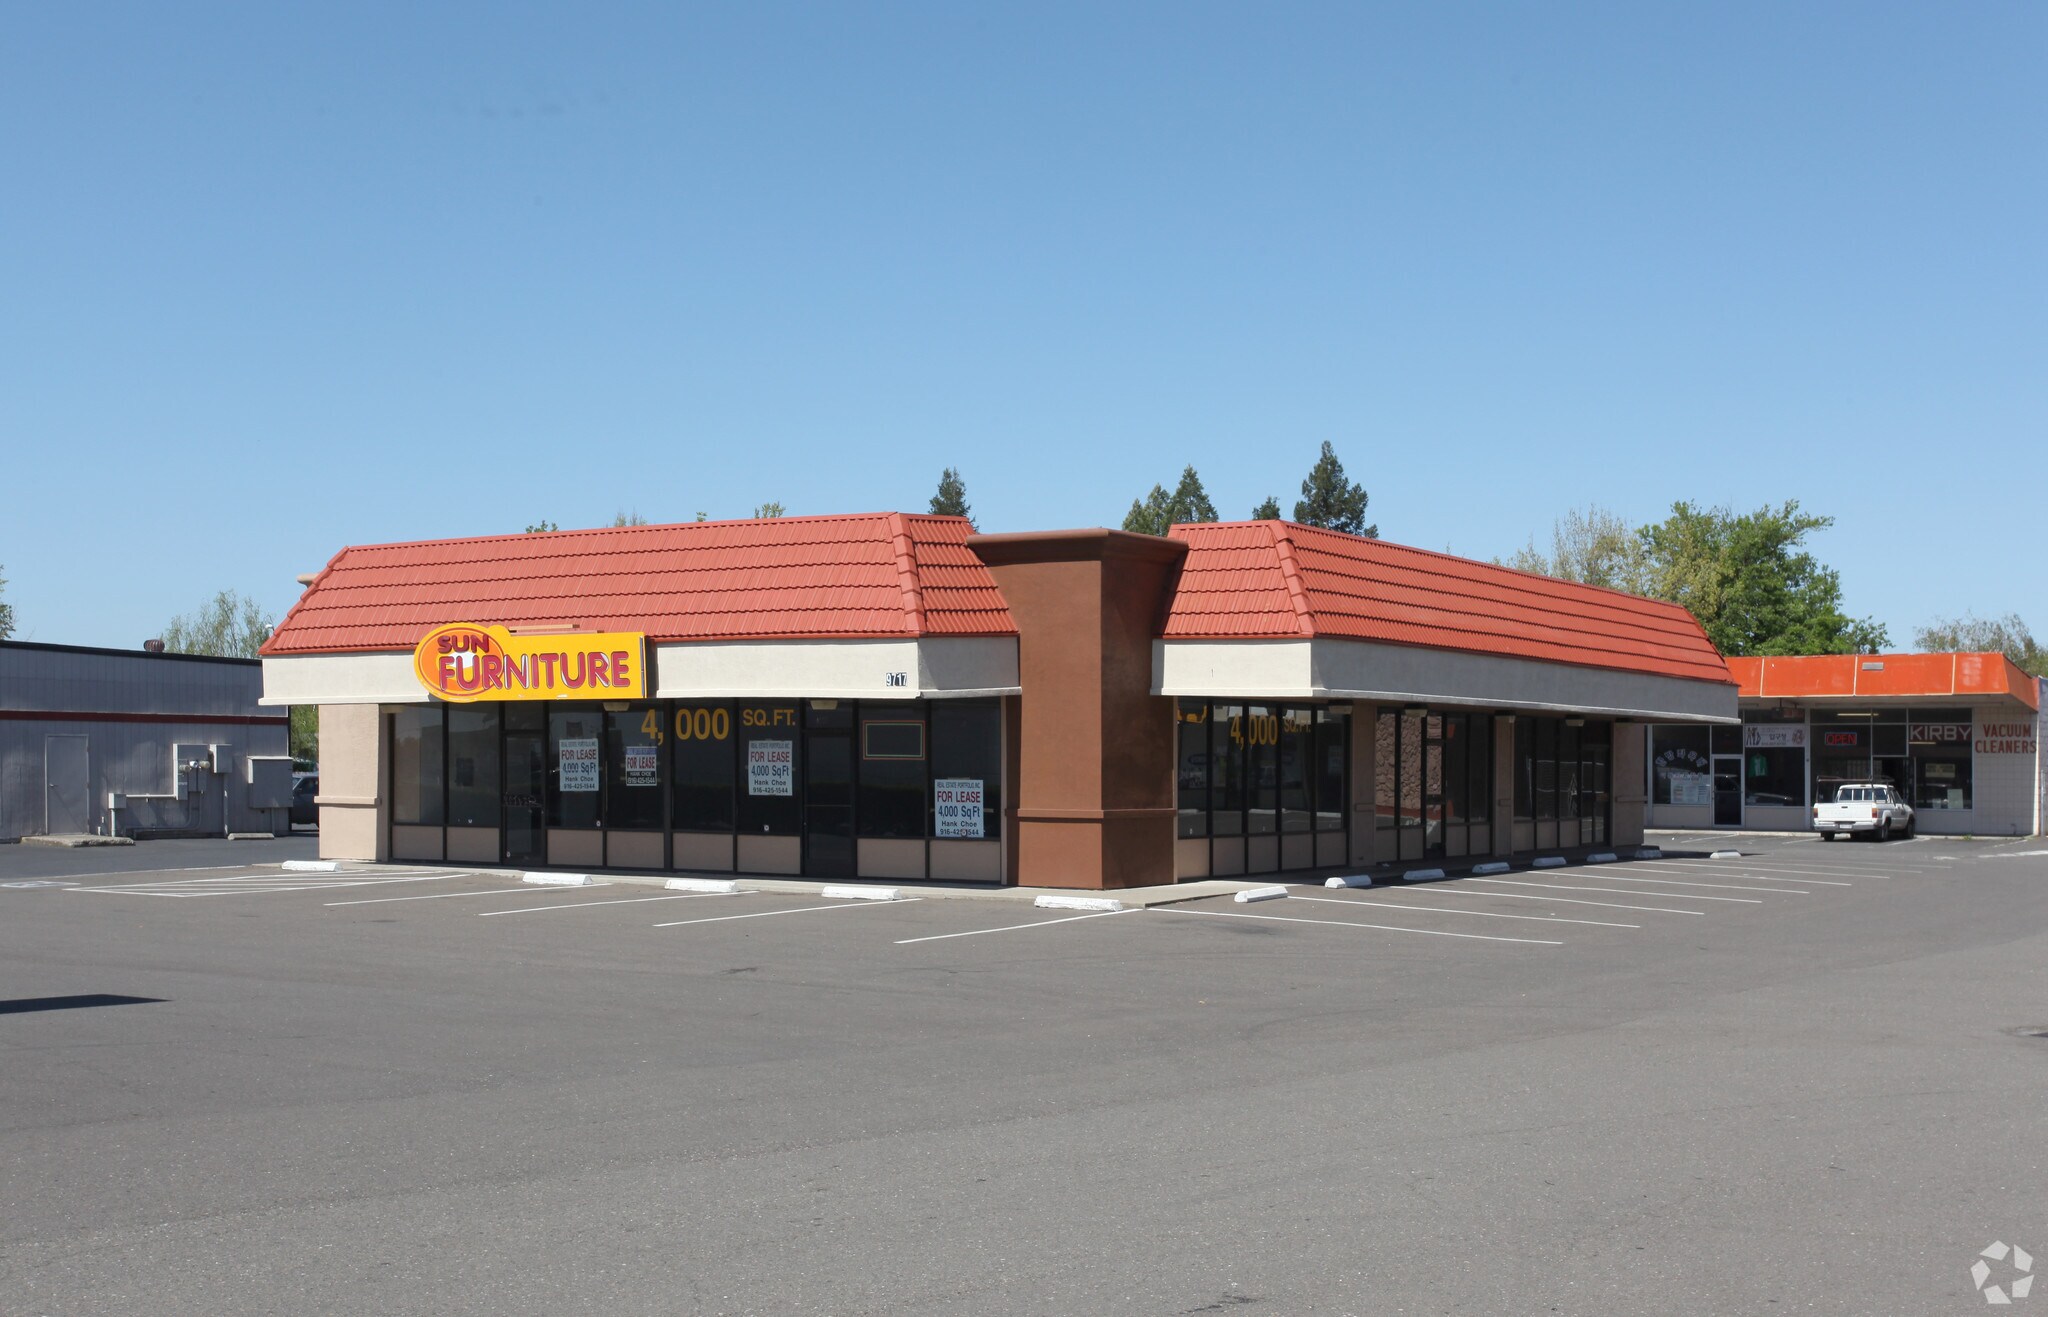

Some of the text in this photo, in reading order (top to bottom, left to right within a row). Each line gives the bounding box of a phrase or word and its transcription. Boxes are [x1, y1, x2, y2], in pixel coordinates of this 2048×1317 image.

[437, 634, 490, 653] SUN
[438, 650, 631, 691] FURNITURE
[886, 671, 908, 687] 9717
[1909, 725, 1972, 741] KIRBY
[1983, 724, 2032, 738] VACUUM
[1826, 733, 1856, 745] OPEN
[1975, 740, 2037, 754] CLEANERS
[561, 749, 597, 761] FOR LEASE
[750, 751, 790, 762] FOR LEASE
[627, 757, 656, 769] FOR LEASE
[751, 765, 769, 777] 4,000
[937, 791, 981, 803] FOR LEASE
[938, 805, 959, 818] 4,000
